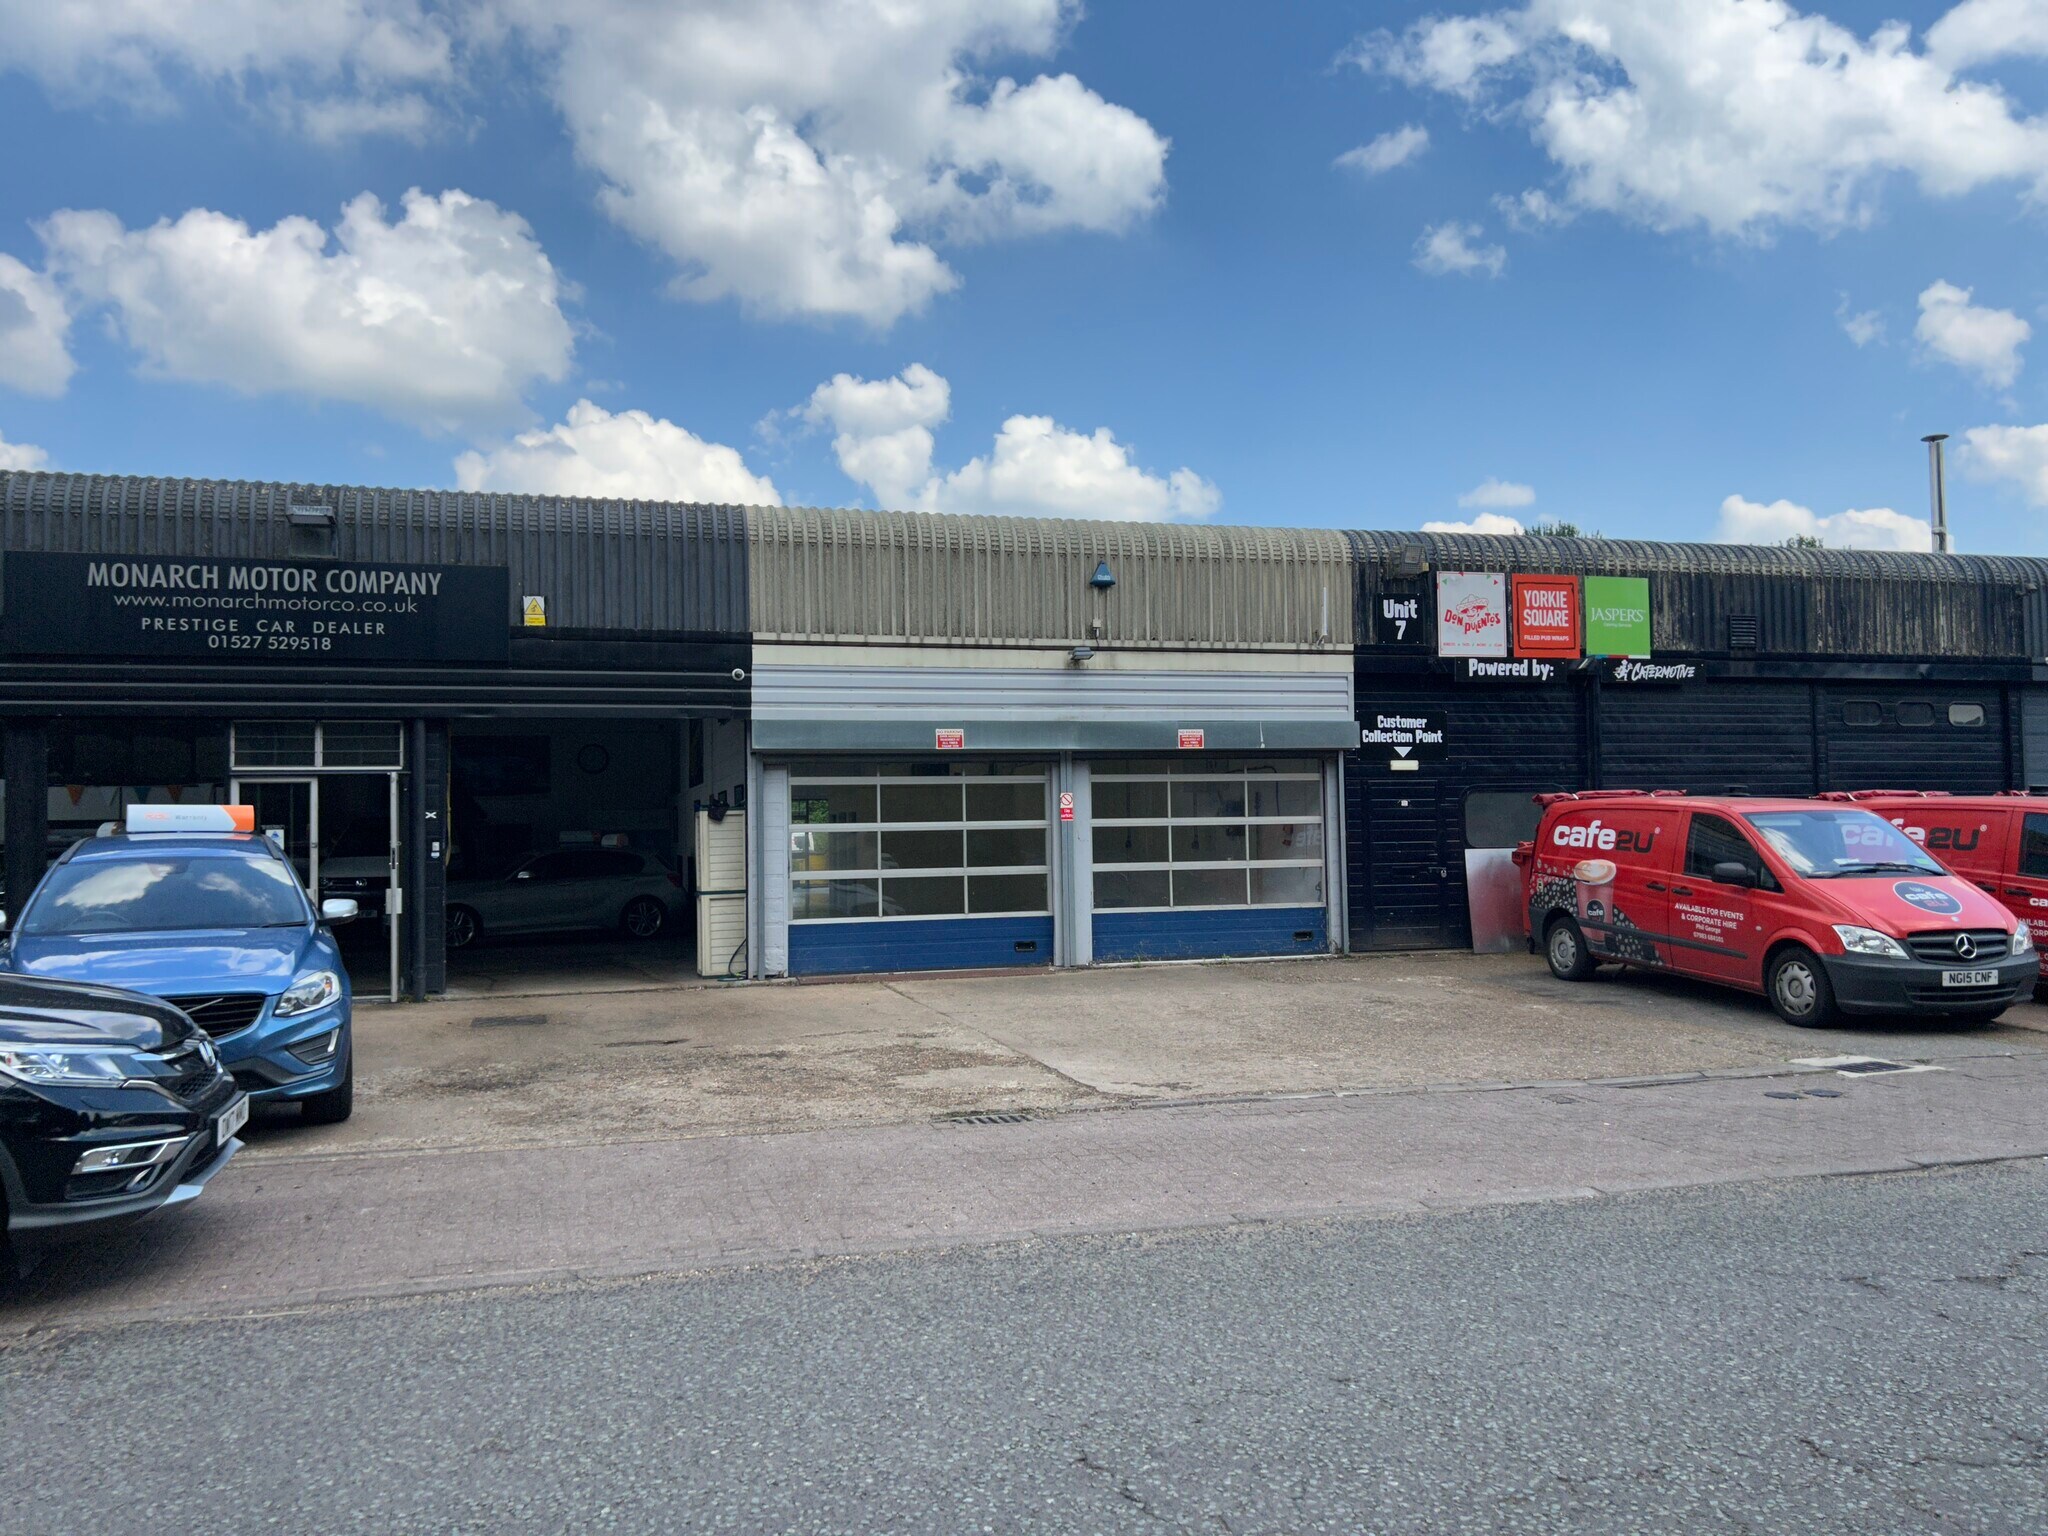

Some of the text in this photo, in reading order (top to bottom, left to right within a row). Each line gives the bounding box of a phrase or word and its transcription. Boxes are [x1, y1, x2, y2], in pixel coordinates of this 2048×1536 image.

[87, 562, 442, 596] MONARCH MOTOR COMPANY
[113, 592, 418, 613] www.monarchmotorco.co.uk
[1523, 590, 1568, 608] YORKIE
[1383, 599, 1418, 619] Unit
[1444, 609, 1464, 626] DON
[1523, 609, 1569, 627] SQUARE
[1591, 607, 1644, 623] JASPER'S
[141, 617, 386, 635] PRESTIGE CAR DEALER
[1395, 620, 1407, 640] 7
[208, 635, 332, 650] 01527 529518
[1468, 658, 1554, 681] Powered by:
[1631, 662, 1696, 682] CATERMOTIVE
[1377, 714, 1428, 729] Customer
[1362, 729, 1443, 744] Collection Point
[1674, 902, 1744, 921] AVAILABLE FOR EVENTS
[1681, 912, 1737, 930] & CORPORATE HIRE
[1949, 971, 1993, 984] NG15 CNF
